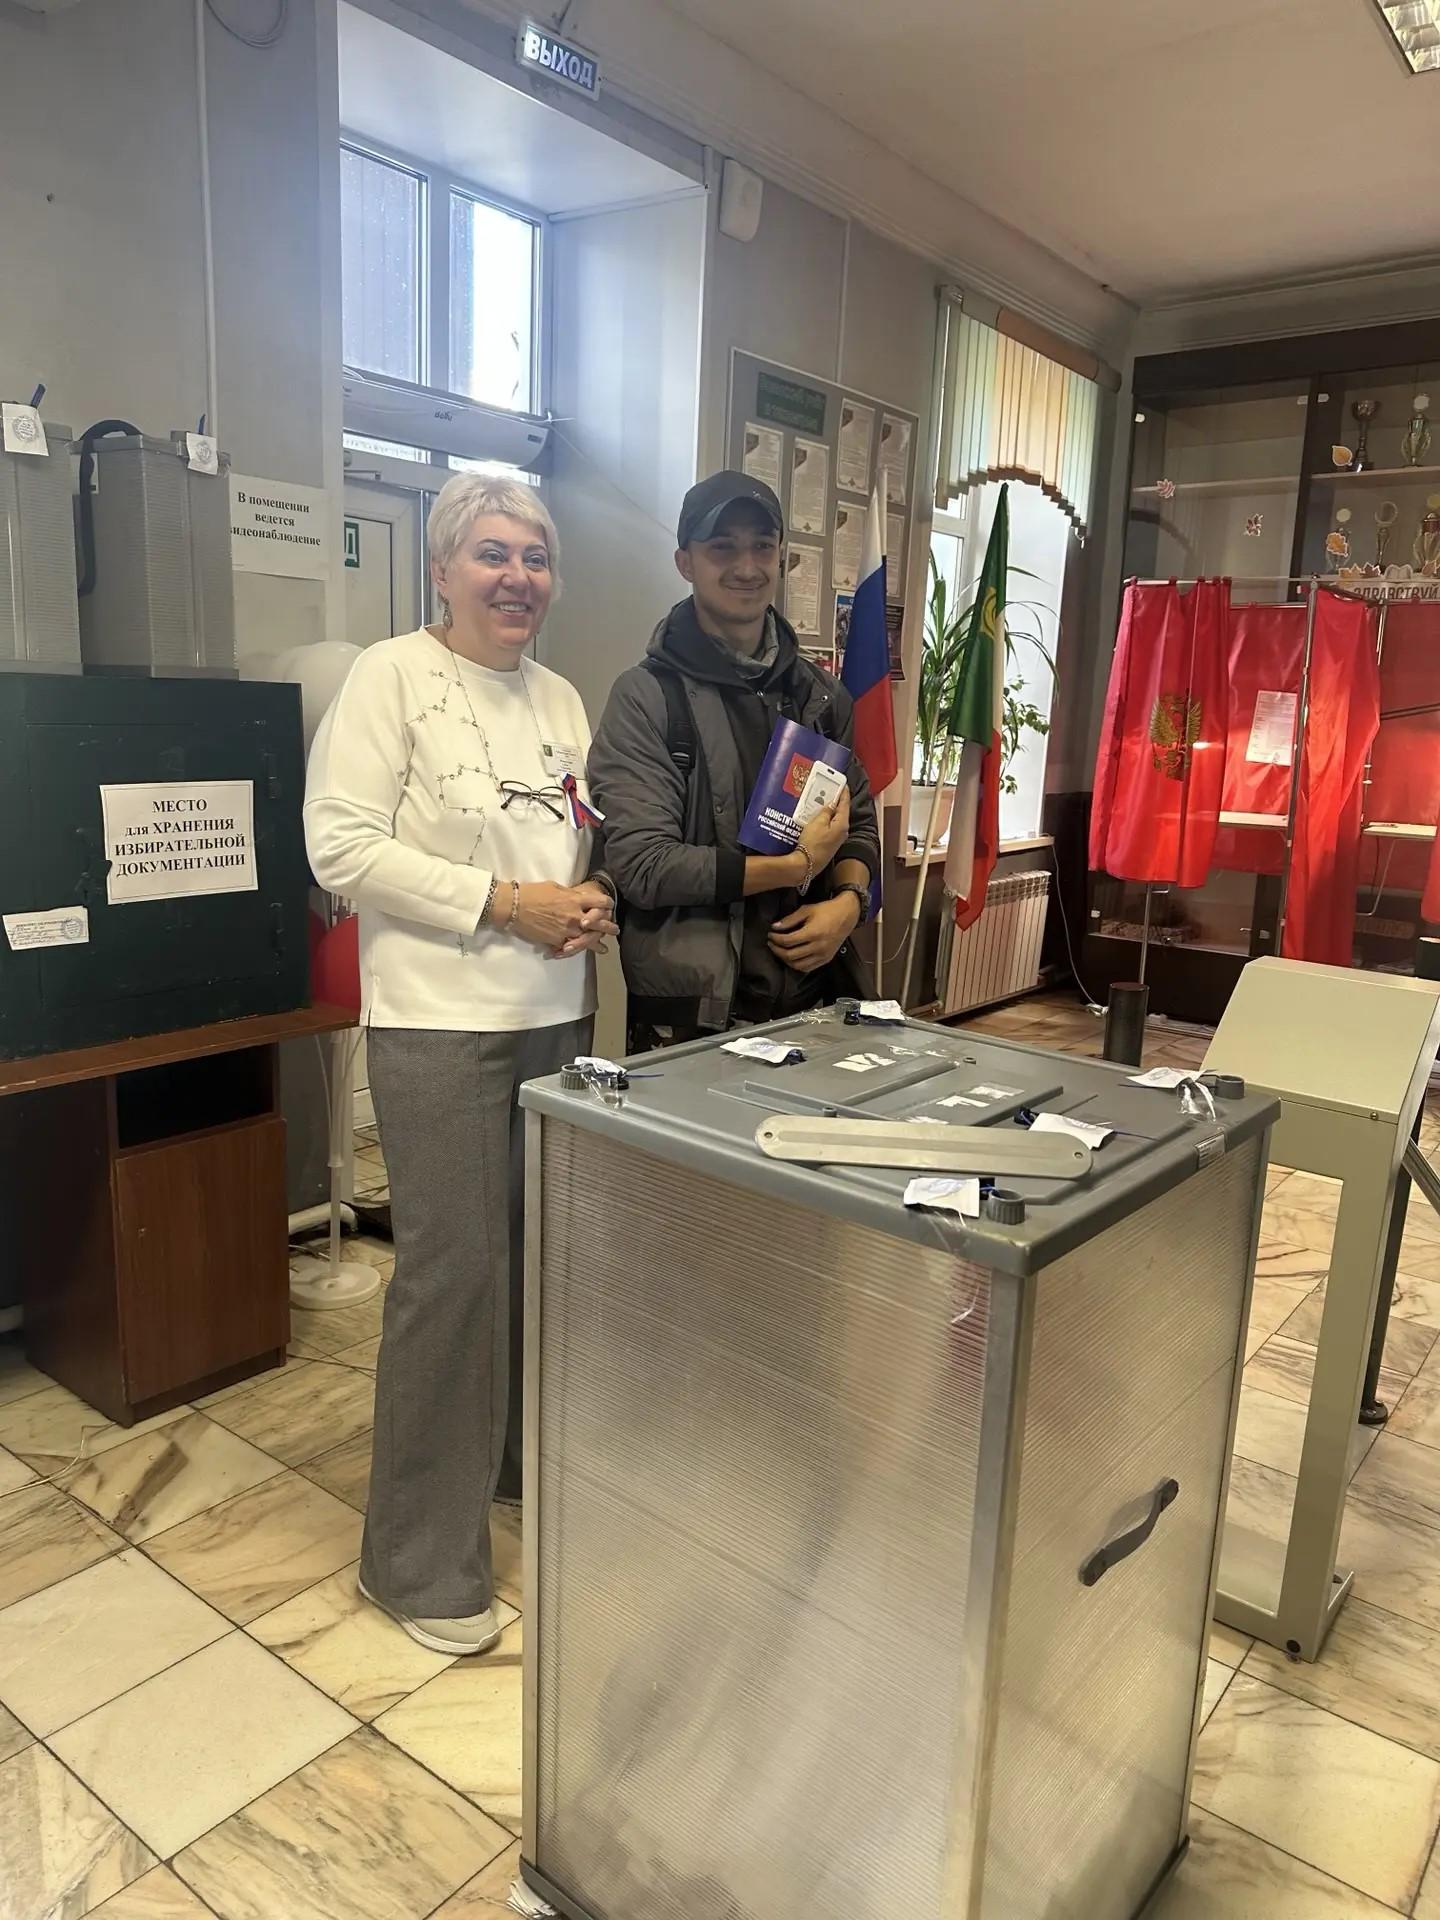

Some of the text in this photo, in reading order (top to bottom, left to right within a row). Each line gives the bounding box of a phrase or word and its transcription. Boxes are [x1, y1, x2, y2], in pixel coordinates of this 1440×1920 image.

[523, 31, 593, 89] ВЫХОД
[238, 491, 310, 513] В помещении
[255, 513, 295, 527] ведется
[230, 526, 321, 546] идеонаблюдение
[152, 799, 207, 813] МЕСТО
[125, 818, 234, 837] для ХРАНЕНИЯ
[115, 834, 245, 856] ИЗБИРАТЕЛЬНОЙ
[116, 854, 245, 877] ДОКУМЕНТАЦИИ
